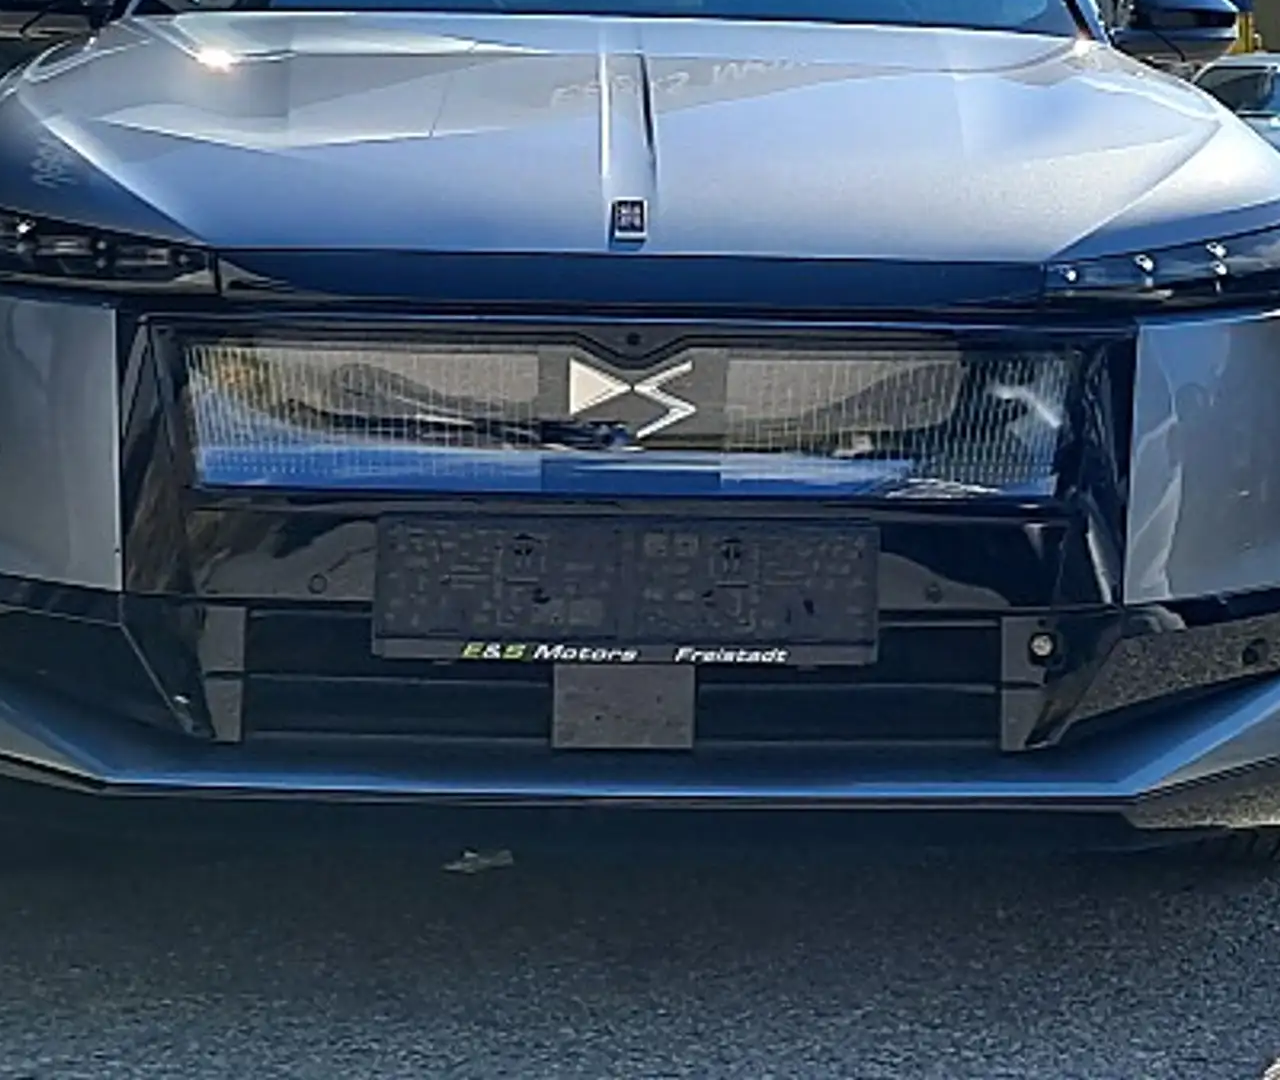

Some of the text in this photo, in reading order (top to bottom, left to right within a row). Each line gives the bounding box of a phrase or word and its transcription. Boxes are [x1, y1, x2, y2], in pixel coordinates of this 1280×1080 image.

[462, 643, 790, 663] E&S Motors Freistadt
